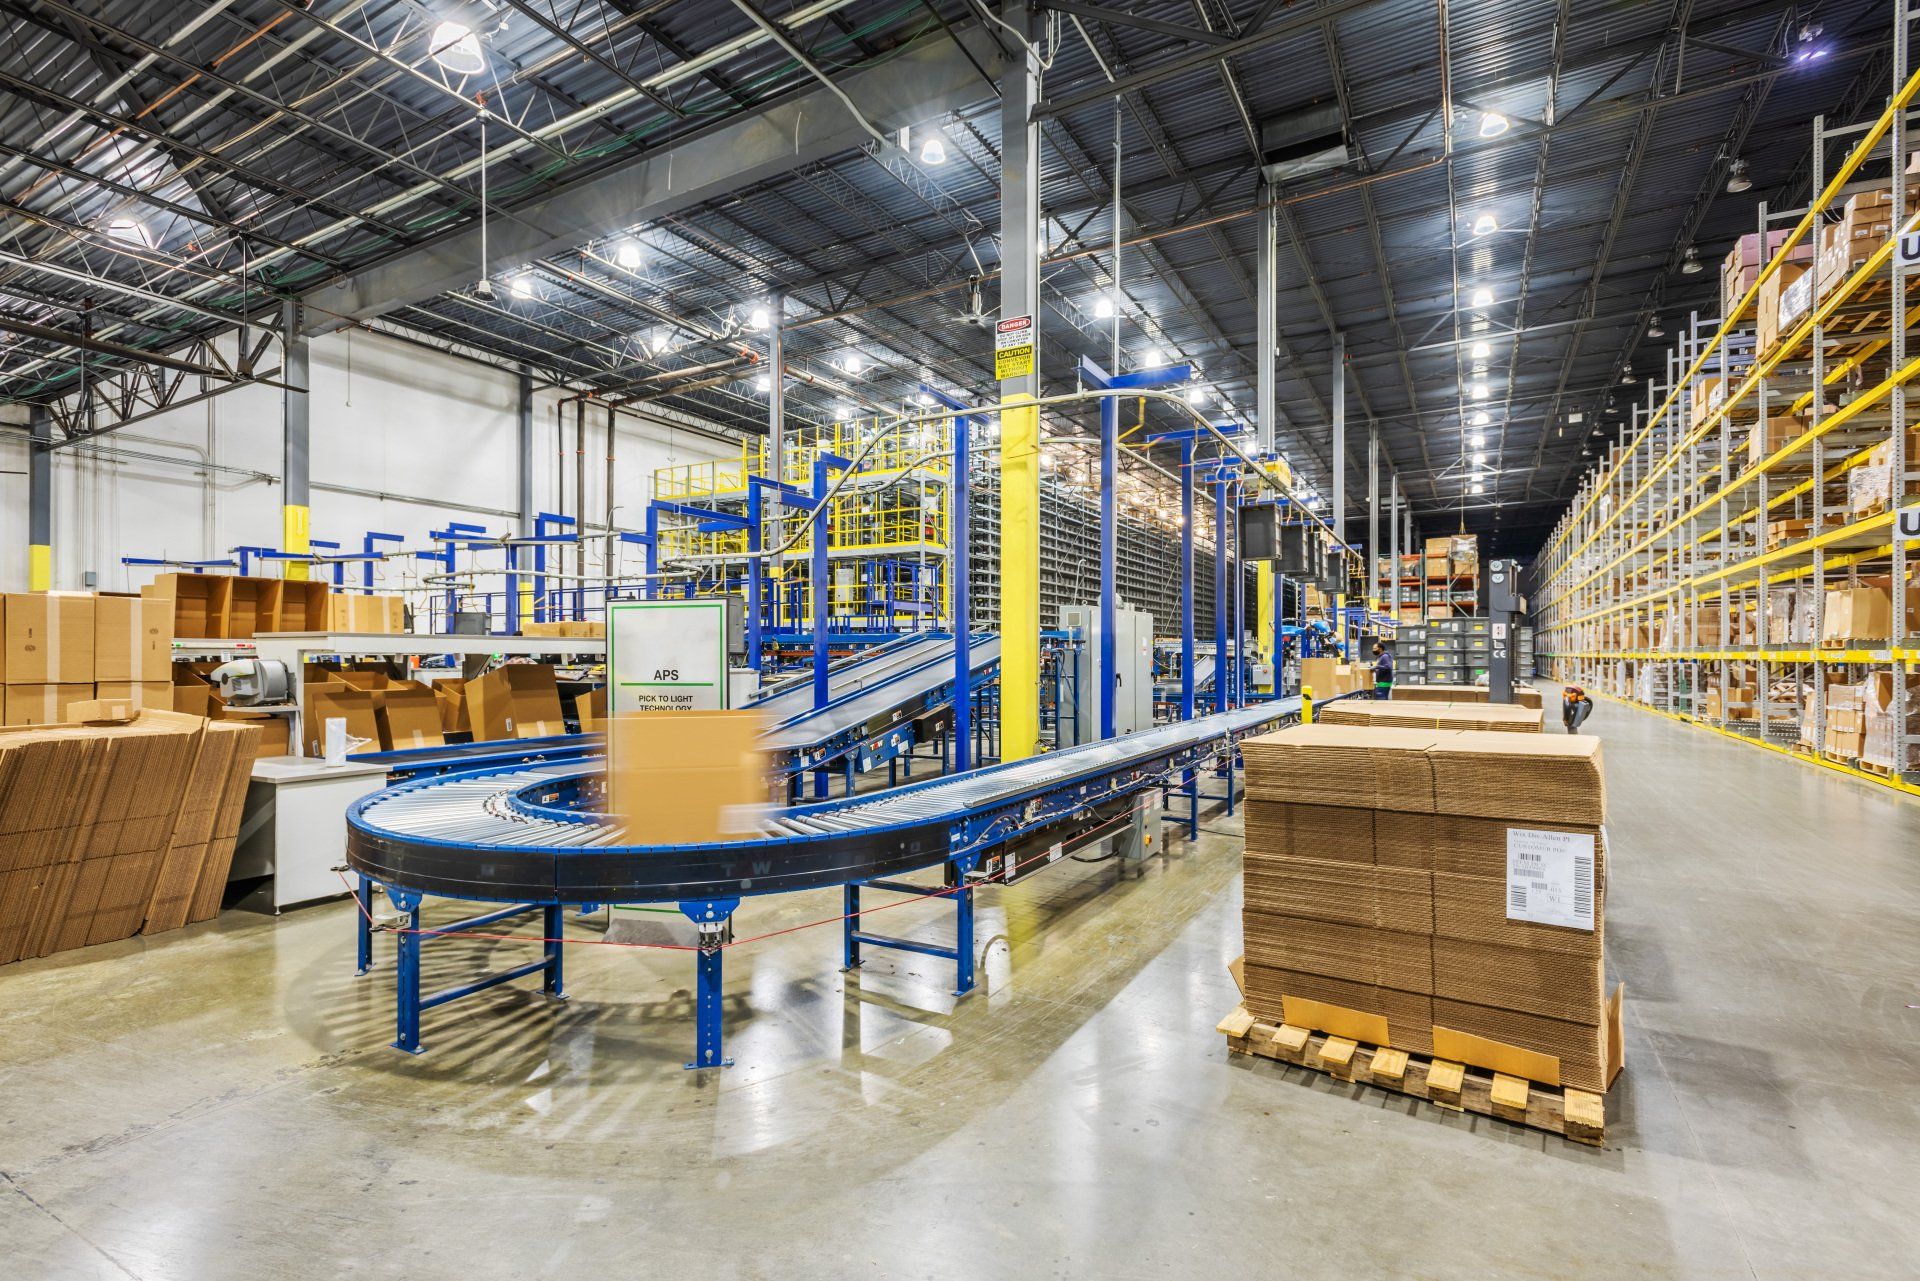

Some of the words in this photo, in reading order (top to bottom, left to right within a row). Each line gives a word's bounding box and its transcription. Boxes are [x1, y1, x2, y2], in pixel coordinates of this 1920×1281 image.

[1001, 320, 1027, 330] DANGER
[999, 347, 1030, 358] CAUTION
[998, 355, 1030, 364] CONVEYOR
[1000, 365, 1028, 373] WITHOUT
[1900, 513, 1920, 536] U
[654, 670, 679, 680] APS
